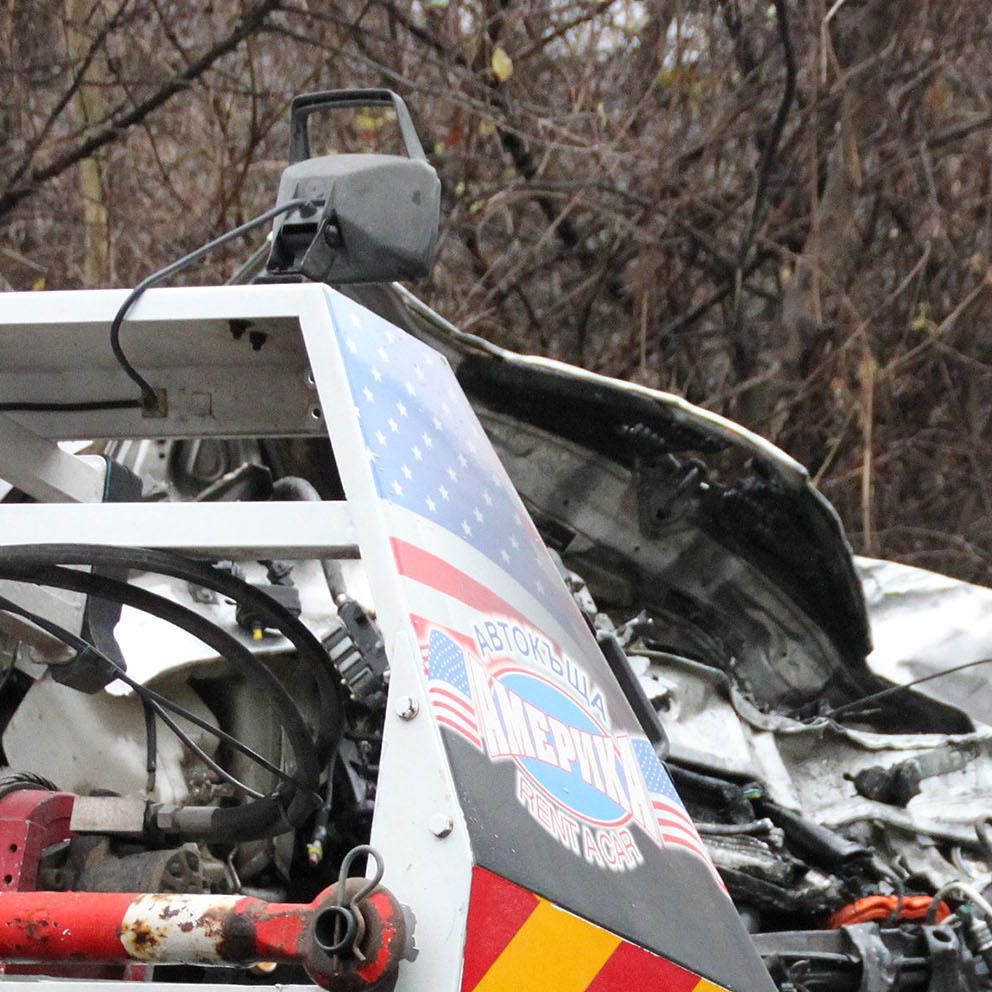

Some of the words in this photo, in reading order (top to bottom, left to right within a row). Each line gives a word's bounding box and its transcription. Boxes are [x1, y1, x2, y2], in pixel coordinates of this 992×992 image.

[474, 621, 607, 722] АВТОКЪЩА
[470, 655, 660, 842] АМЕРИКА
[518, 772, 579, 855] RENT
[583, 829, 604, 867] A
[598, 830, 642, 870] CAR
